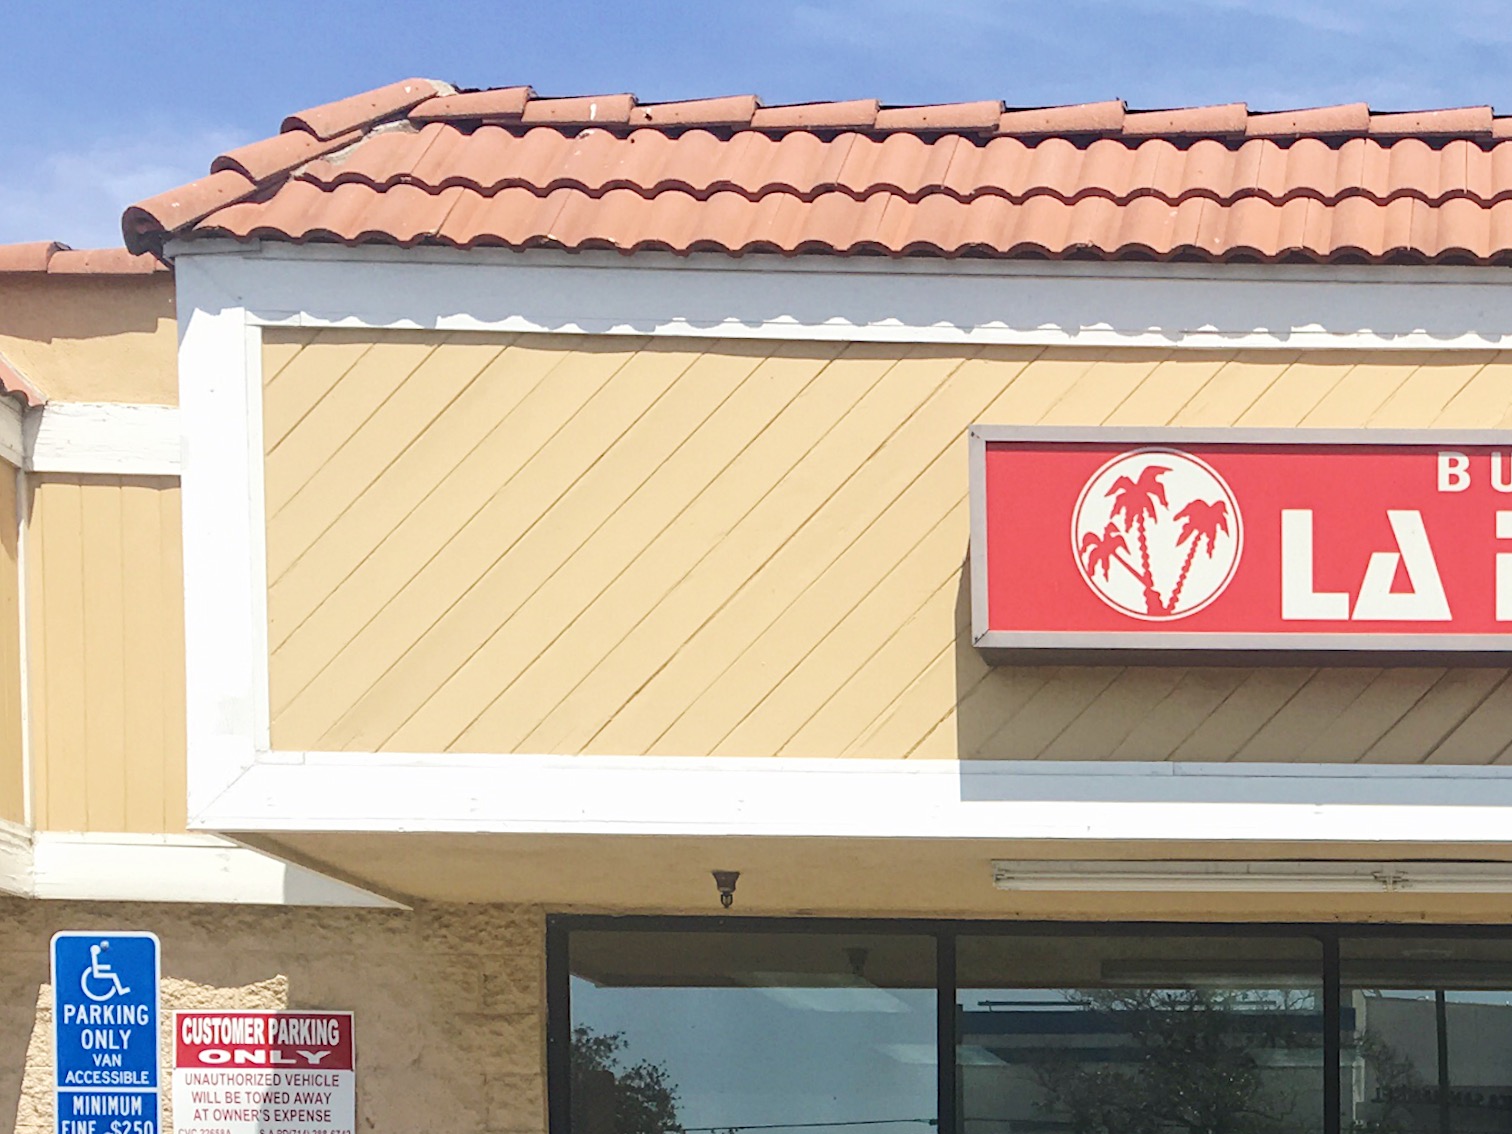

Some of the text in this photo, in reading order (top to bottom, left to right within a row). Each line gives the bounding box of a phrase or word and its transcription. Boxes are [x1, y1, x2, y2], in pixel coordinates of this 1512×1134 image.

[1281, 508, 1452, 622] LA
[63, 1004, 149, 1026] PARKING
[81, 1029, 132, 1050] ONLY
[182, 1017, 340, 1046] CUSTOMER PARKING
[92, 1053, 122, 1067] VAN
[198, 1049, 331, 1065] ONLY
[65, 1070, 150, 1085] ACCESSIBLE
[184, 1072, 340, 1088] UNAUTHORIZED VEHICLE
[73, 1095, 142, 1116] MINIMUM
[191, 1091, 332, 1105] WILL BE TOWED AWAY
[193, 1109, 332, 1123] AT OWNER'S EXPENSE
